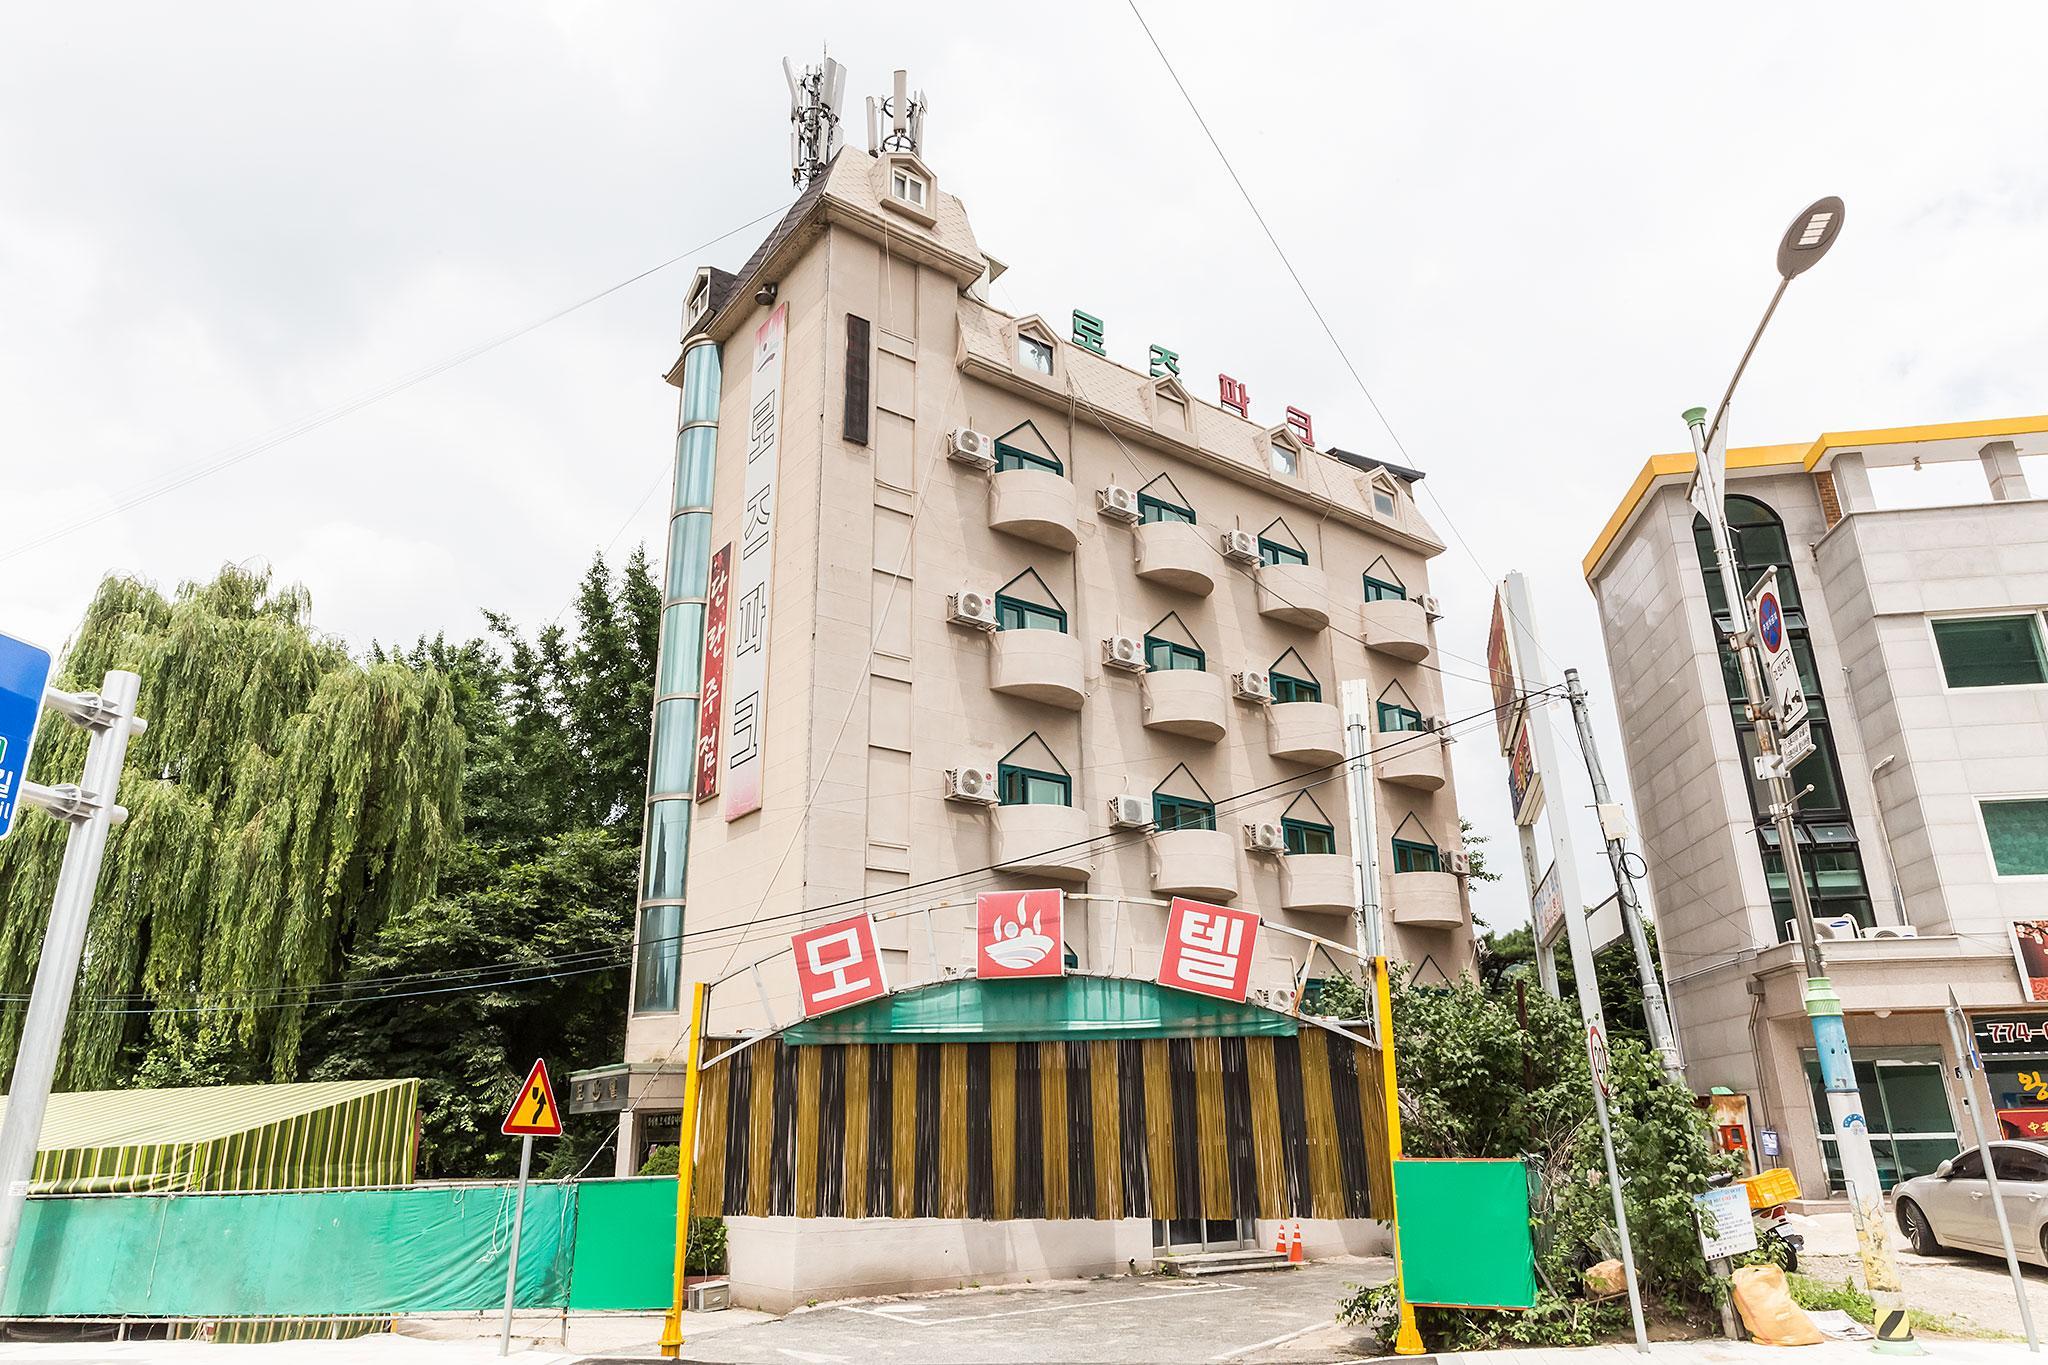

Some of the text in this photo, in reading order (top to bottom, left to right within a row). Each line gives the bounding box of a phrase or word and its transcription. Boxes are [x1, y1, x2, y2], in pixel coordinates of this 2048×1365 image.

[699, 570, 728, 772] 단란주점
[805, 909, 1246, 1004] 모 텔
